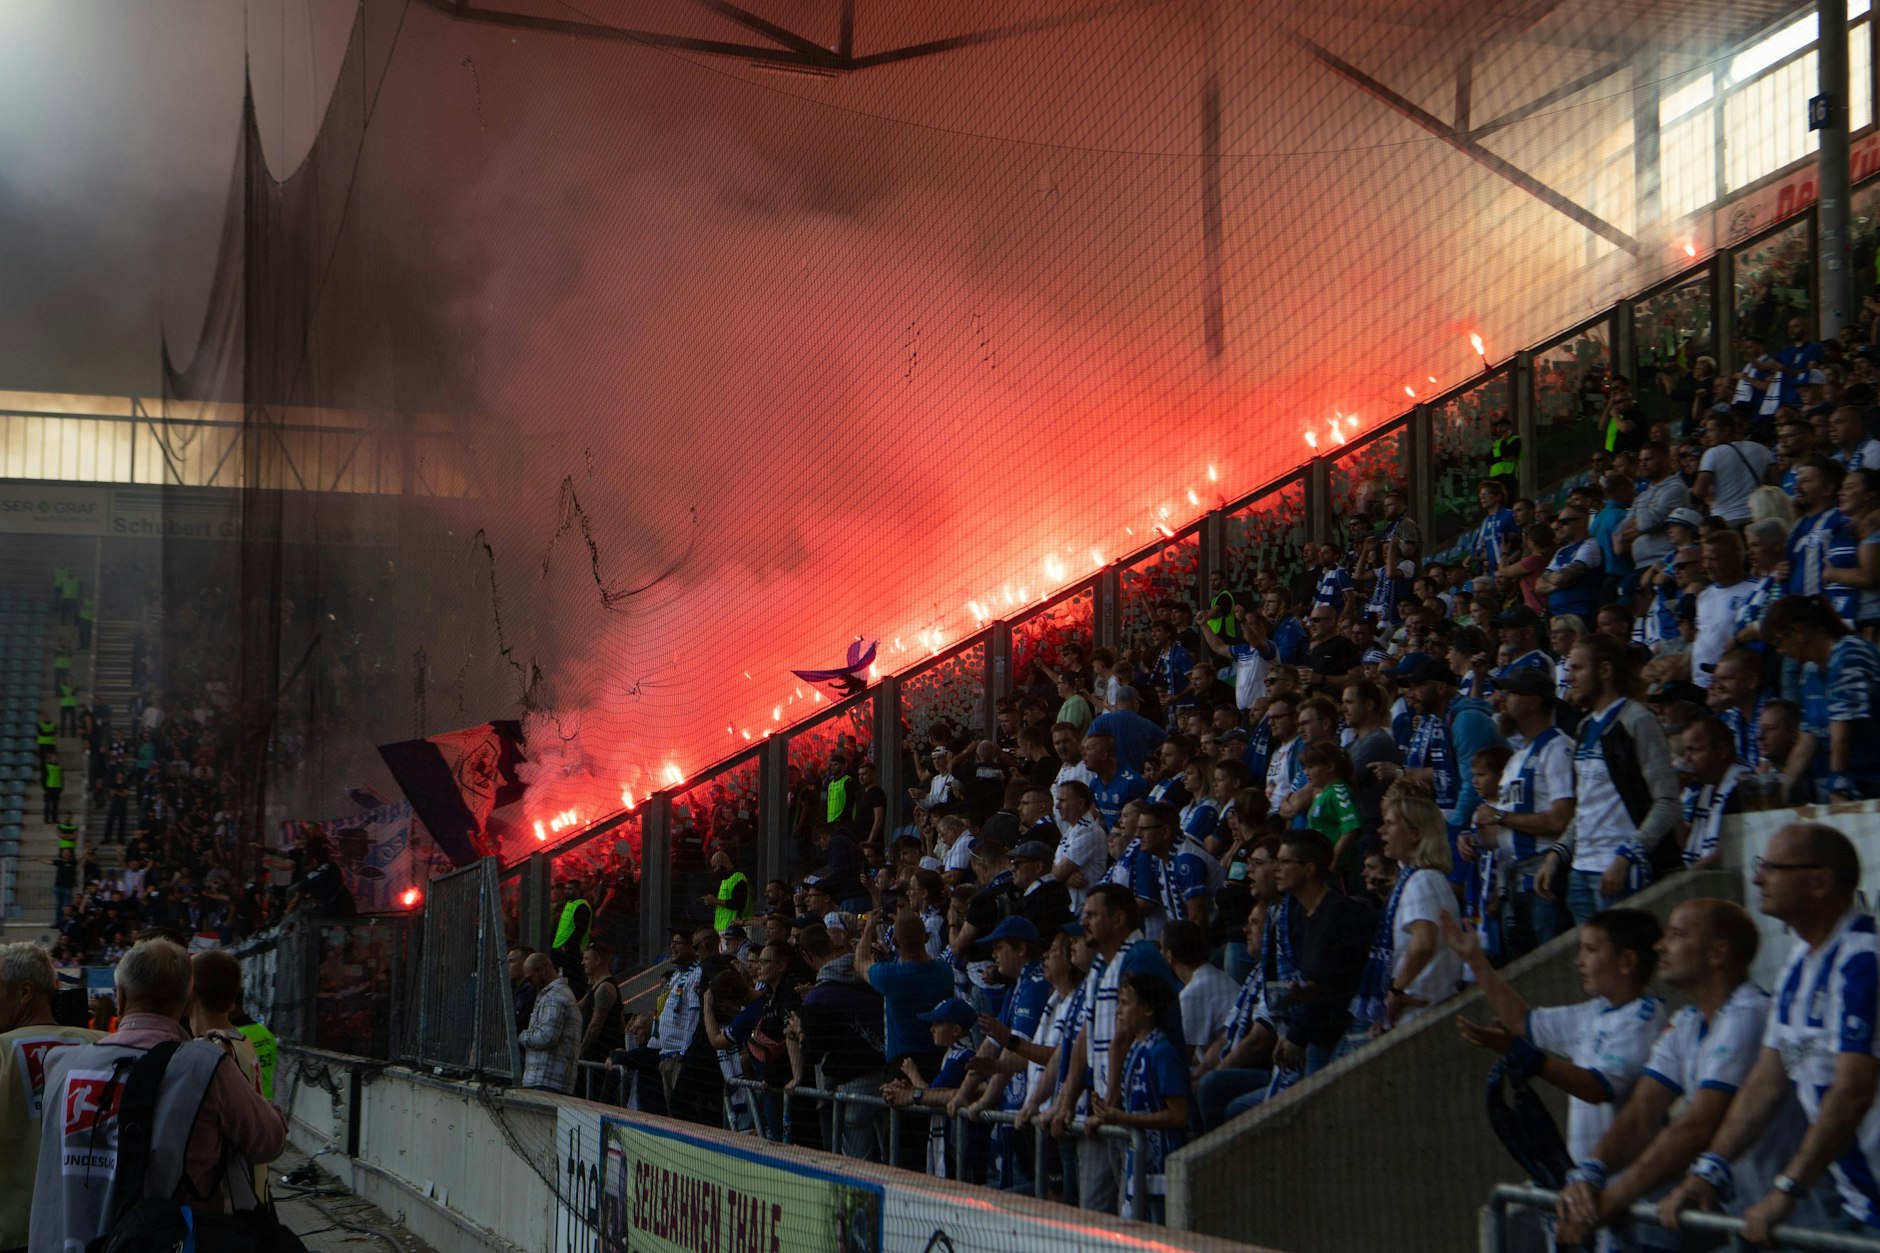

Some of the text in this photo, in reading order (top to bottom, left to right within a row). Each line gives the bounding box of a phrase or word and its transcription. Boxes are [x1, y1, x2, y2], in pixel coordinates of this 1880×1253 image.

[1811, 99, 1827, 124] 16
[2, 500, 98, 513] SER GRAF
[113, 516, 212, 536] Schubert
[63, 1154, 115, 1170] UNDESLIG
[633, 1159, 722, 1253] SEILBAHNEN
